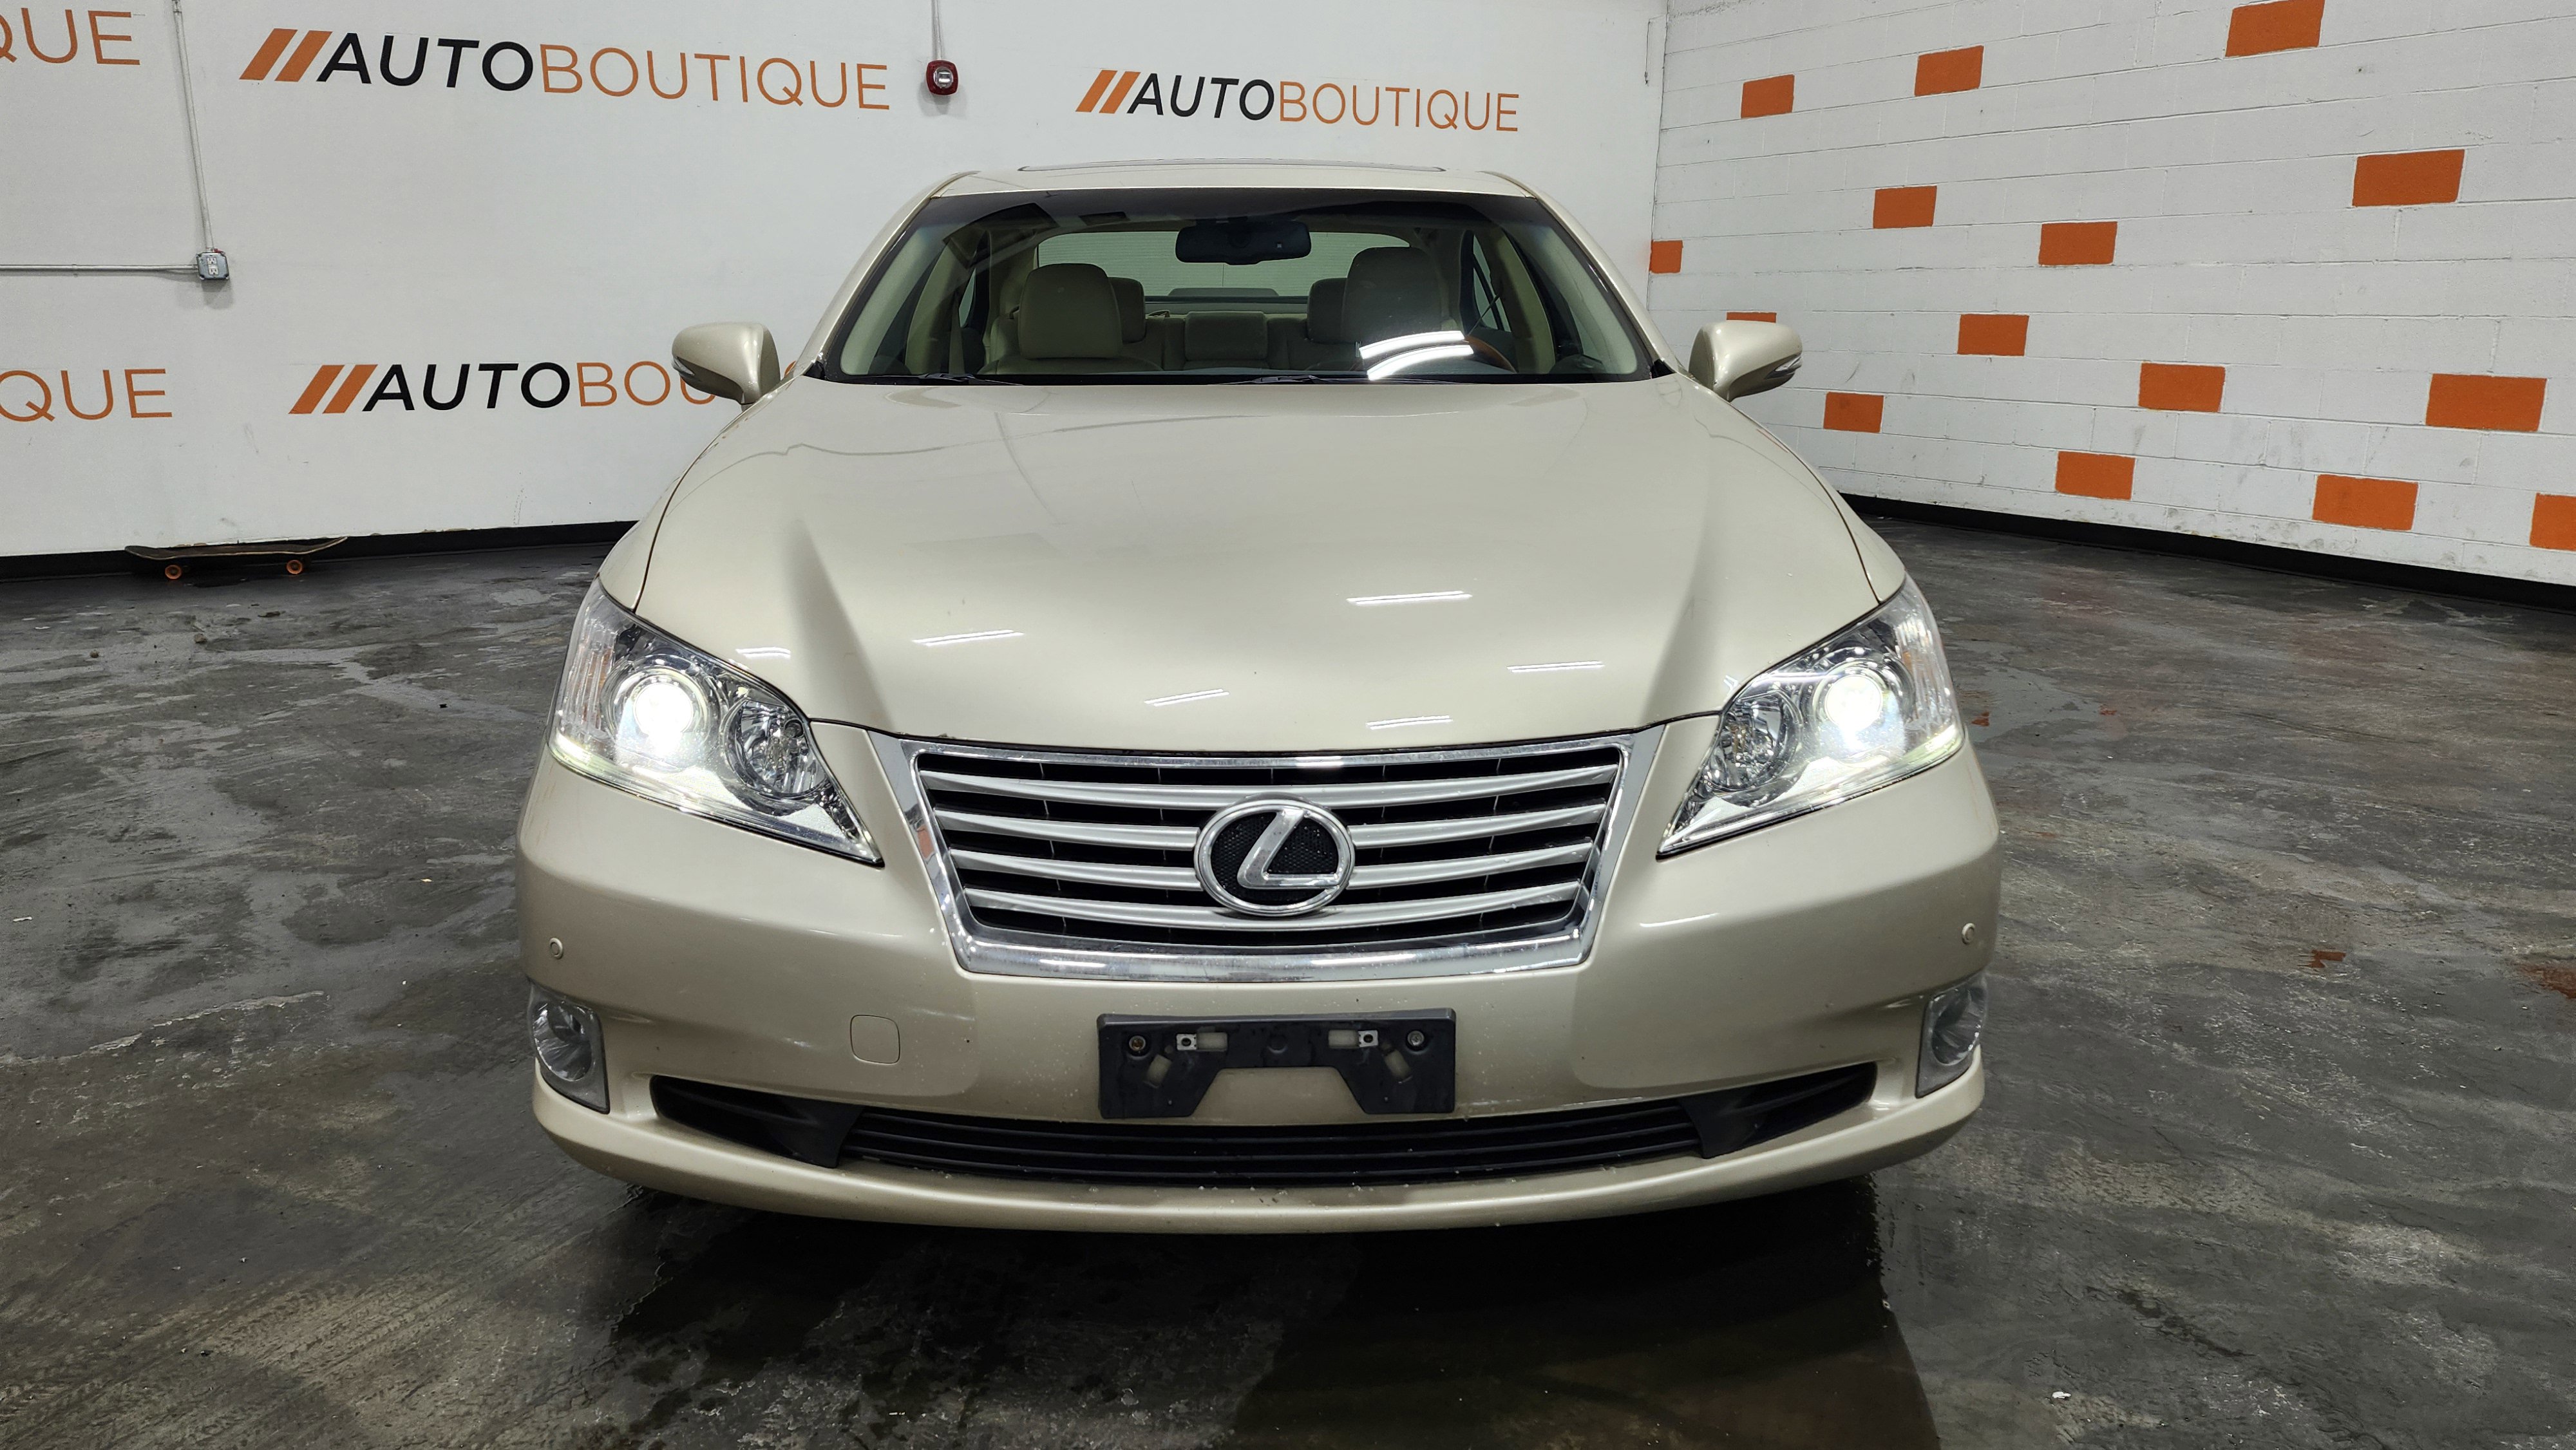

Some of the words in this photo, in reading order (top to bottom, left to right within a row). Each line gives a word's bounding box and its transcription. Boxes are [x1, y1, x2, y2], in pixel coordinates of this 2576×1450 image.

[316, 32, 890, 110] AUTOBOUTIQUE
[1127, 73, 1519, 132] AUTOBOUTIQUE
[0, 368, 173, 422] QUE
